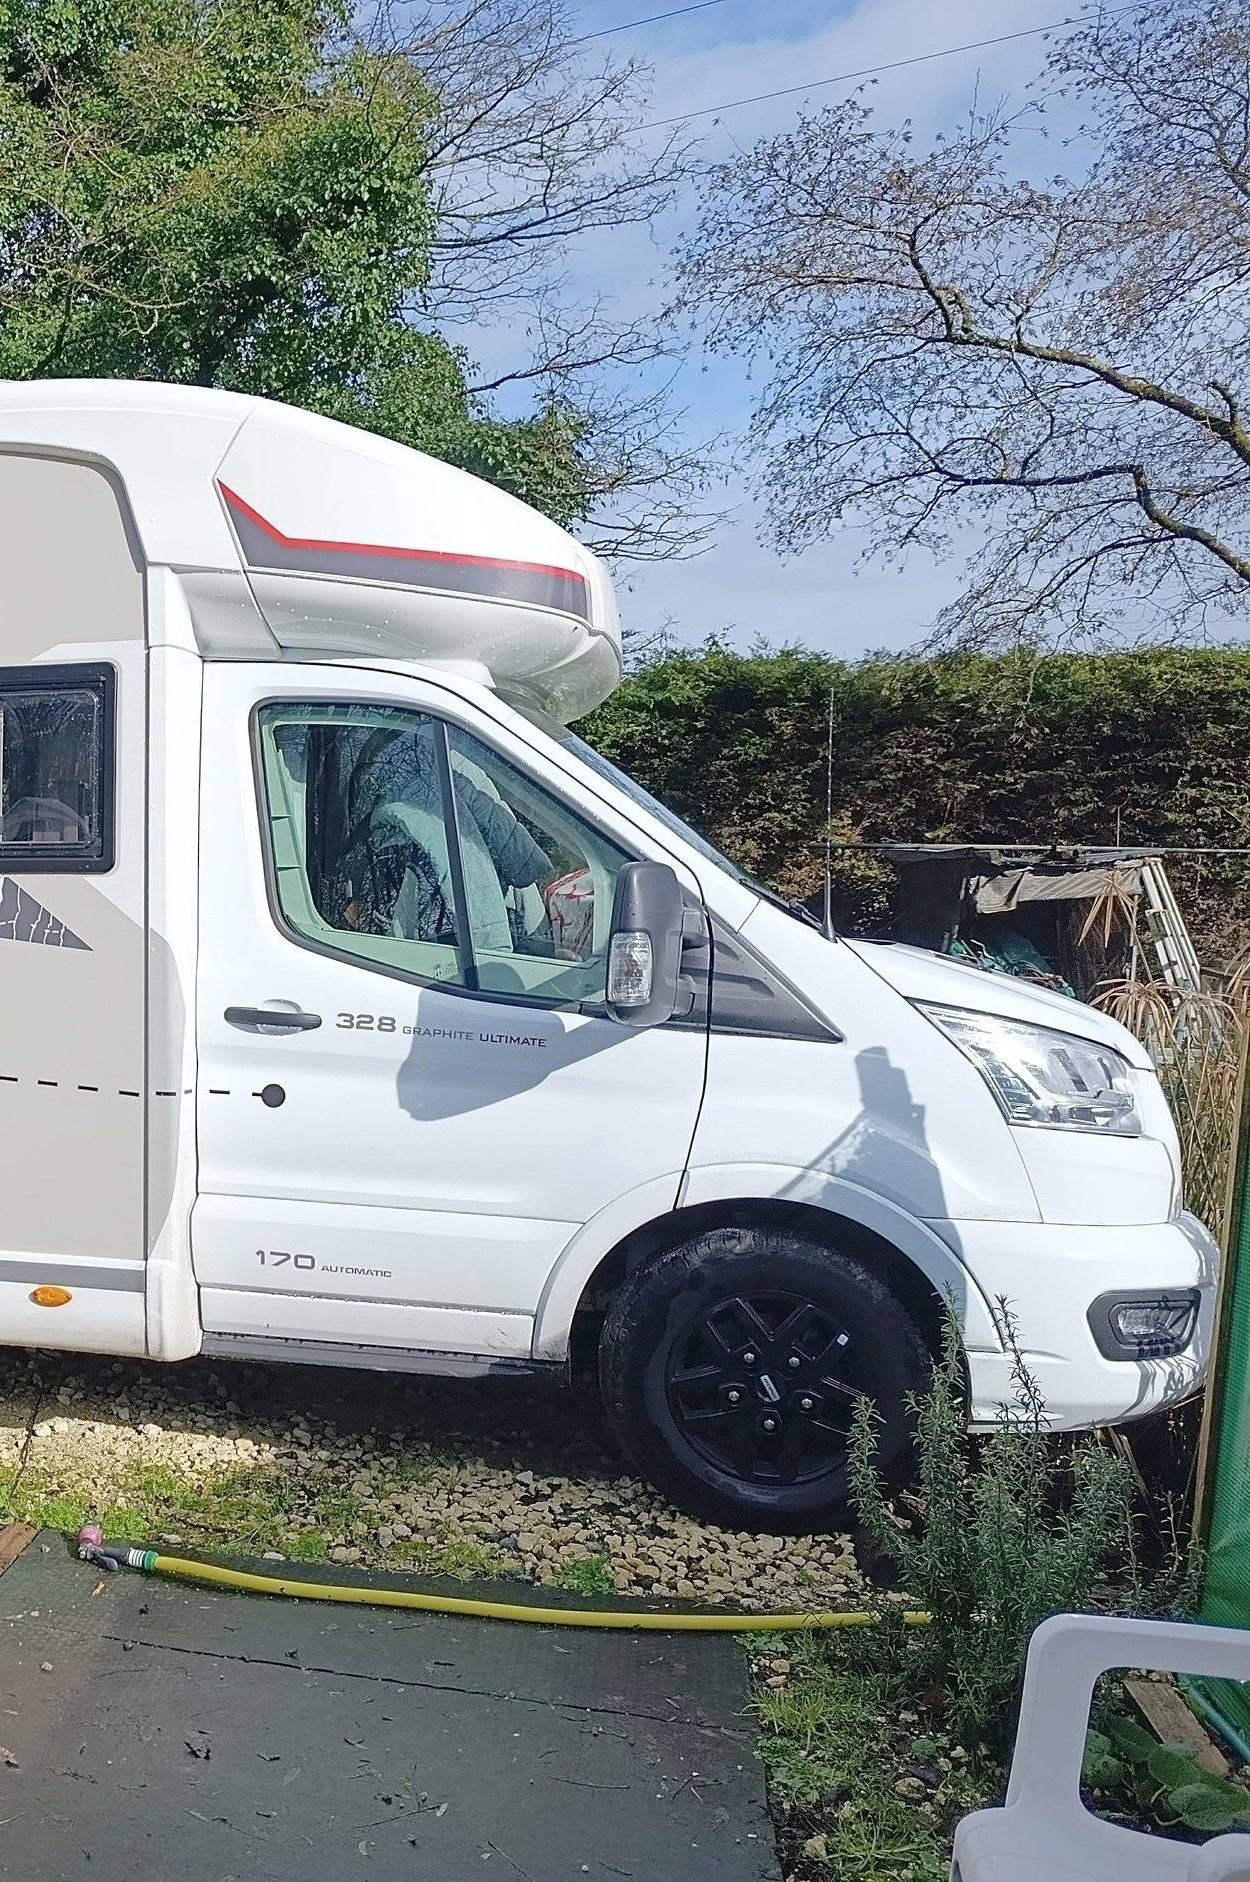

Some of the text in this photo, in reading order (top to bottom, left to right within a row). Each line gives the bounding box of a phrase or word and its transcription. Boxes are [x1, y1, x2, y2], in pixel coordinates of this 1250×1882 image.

[336, 1012, 547, 1048] 328 GRAPHITE ULTIMATE
[255, 1250, 392, 1278] 170 AUTOMATIC
